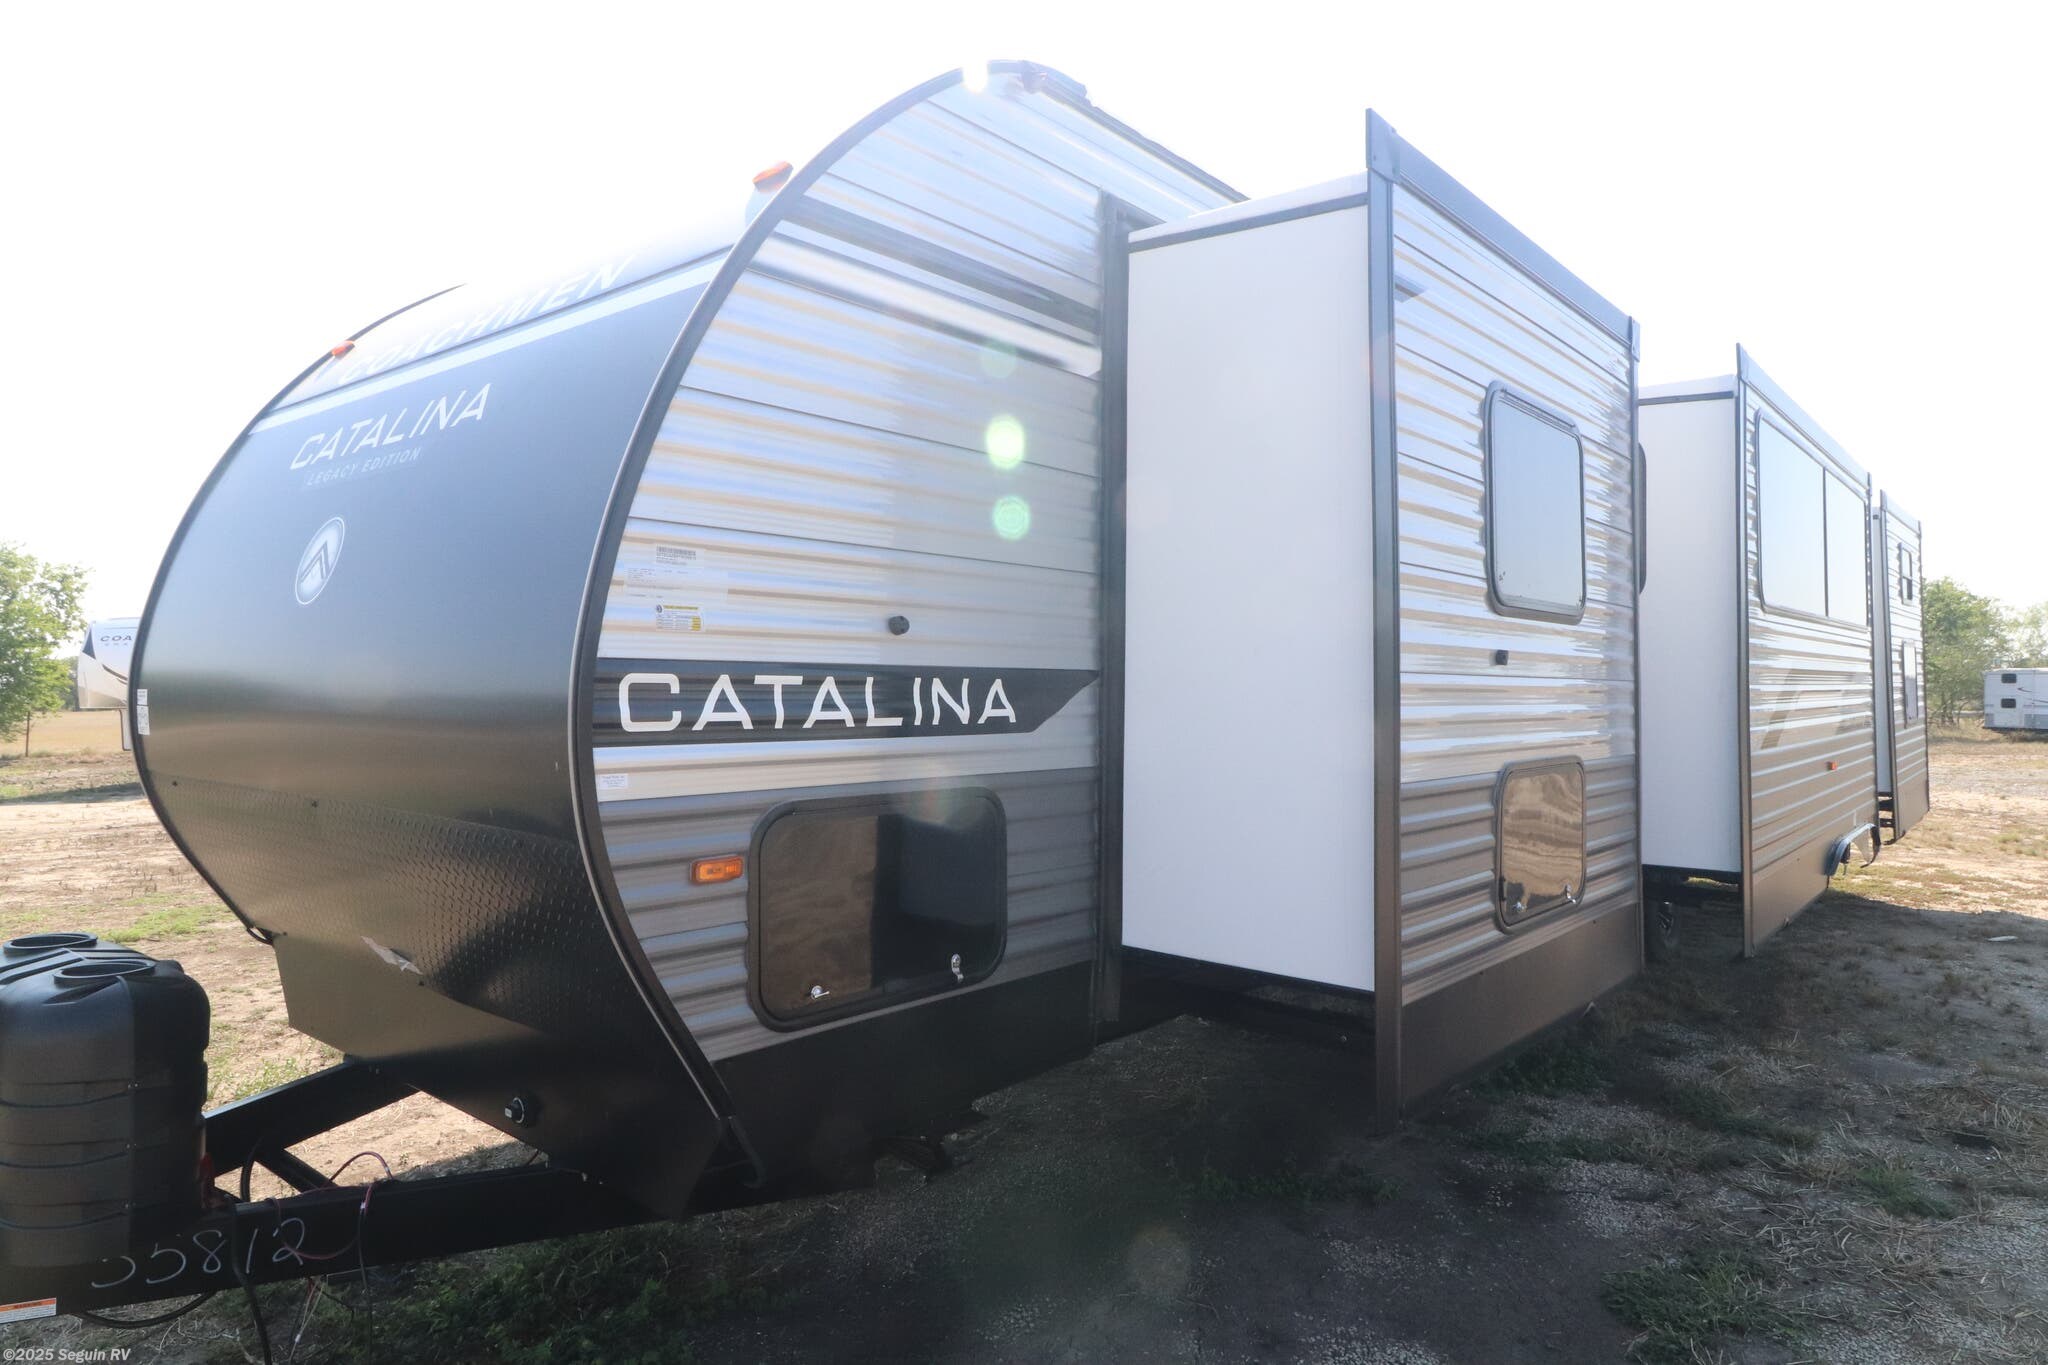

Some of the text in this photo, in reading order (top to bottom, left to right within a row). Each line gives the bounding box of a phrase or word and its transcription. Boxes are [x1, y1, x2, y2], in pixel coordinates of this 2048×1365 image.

[289, 382, 492, 471] CATALINA
[305, 447, 421, 486] LEGACY EDITION
[618, 672, 1017, 733] CATALINA
